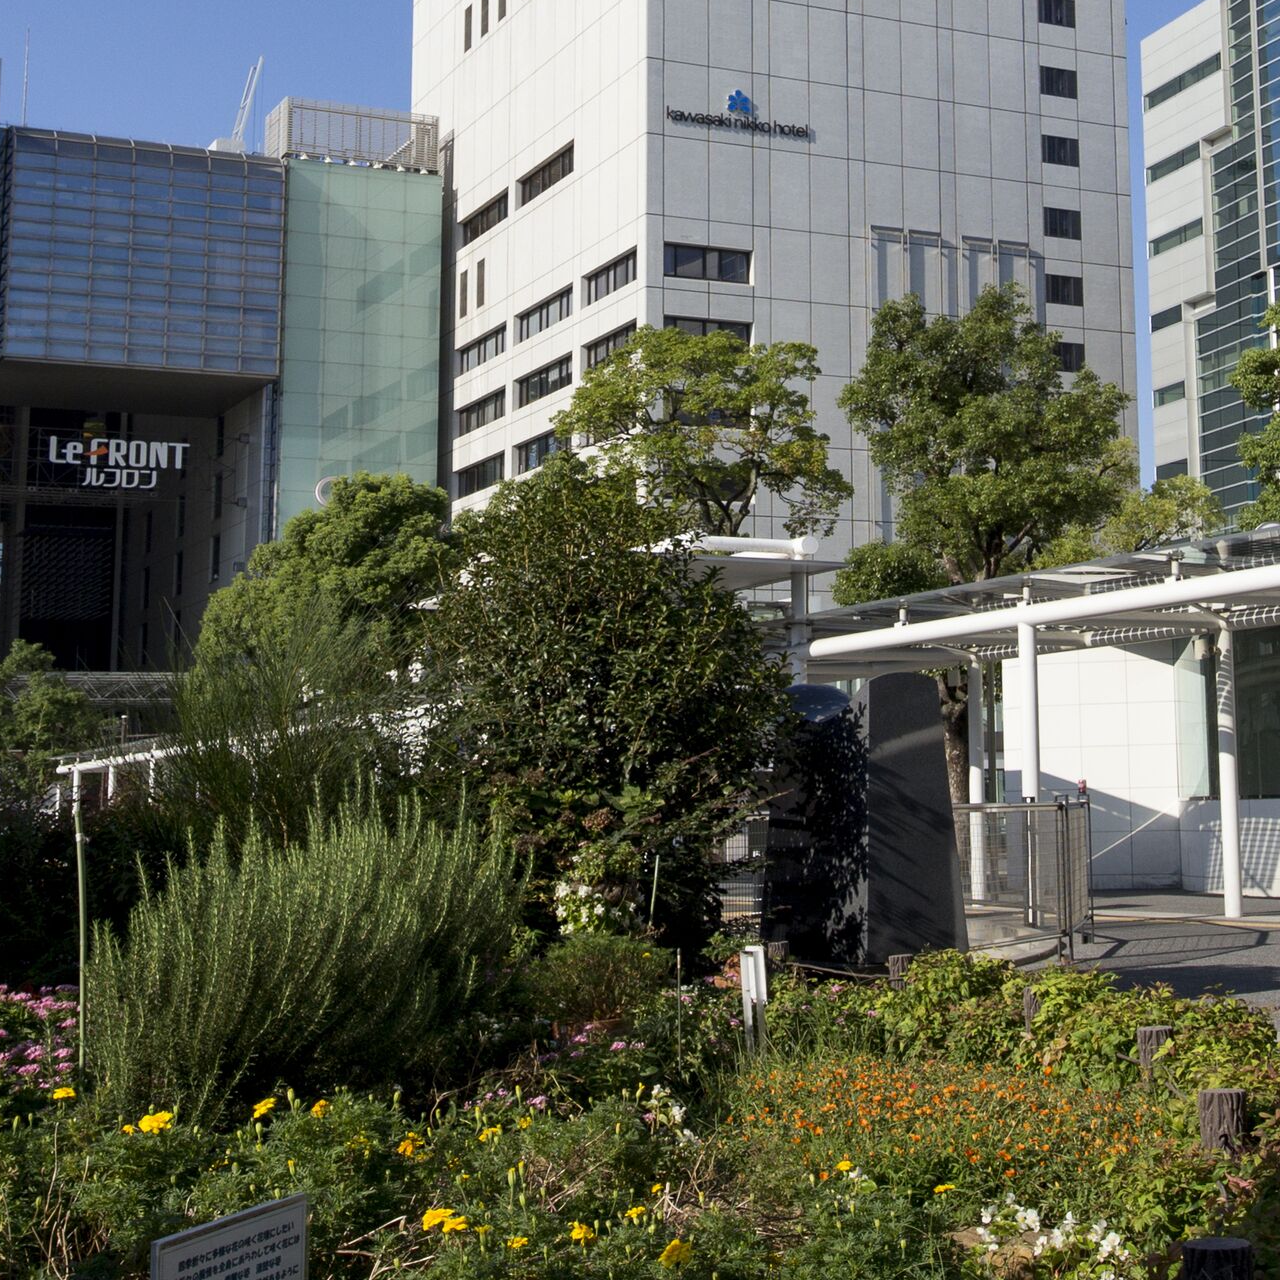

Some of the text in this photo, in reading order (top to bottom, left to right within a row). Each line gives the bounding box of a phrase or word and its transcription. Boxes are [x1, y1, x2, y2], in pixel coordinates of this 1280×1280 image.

[666, 105, 809, 138] kawasaki nikko hotel
[82, 467, 158, 488] ルフロン
